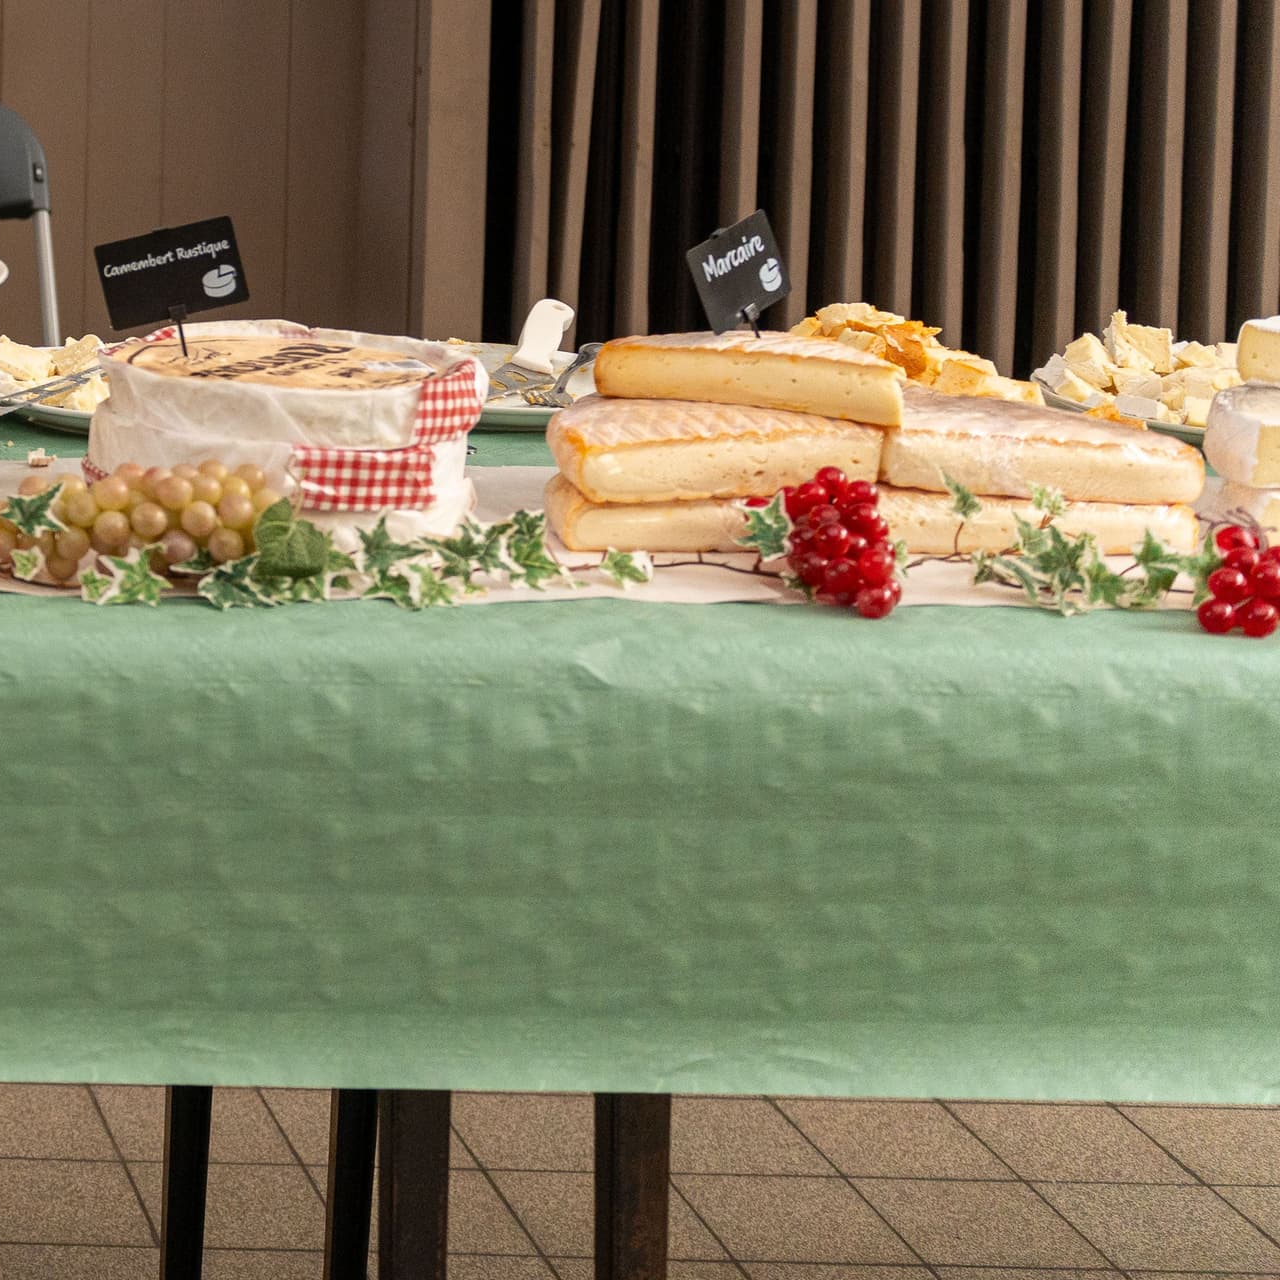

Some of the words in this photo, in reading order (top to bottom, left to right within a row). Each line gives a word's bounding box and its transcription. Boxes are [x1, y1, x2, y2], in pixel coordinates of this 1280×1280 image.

[103, 251, 175, 278] Camembert
[175, 239, 231, 259] Rustique
[702, 235, 765, 283] Marcaire
